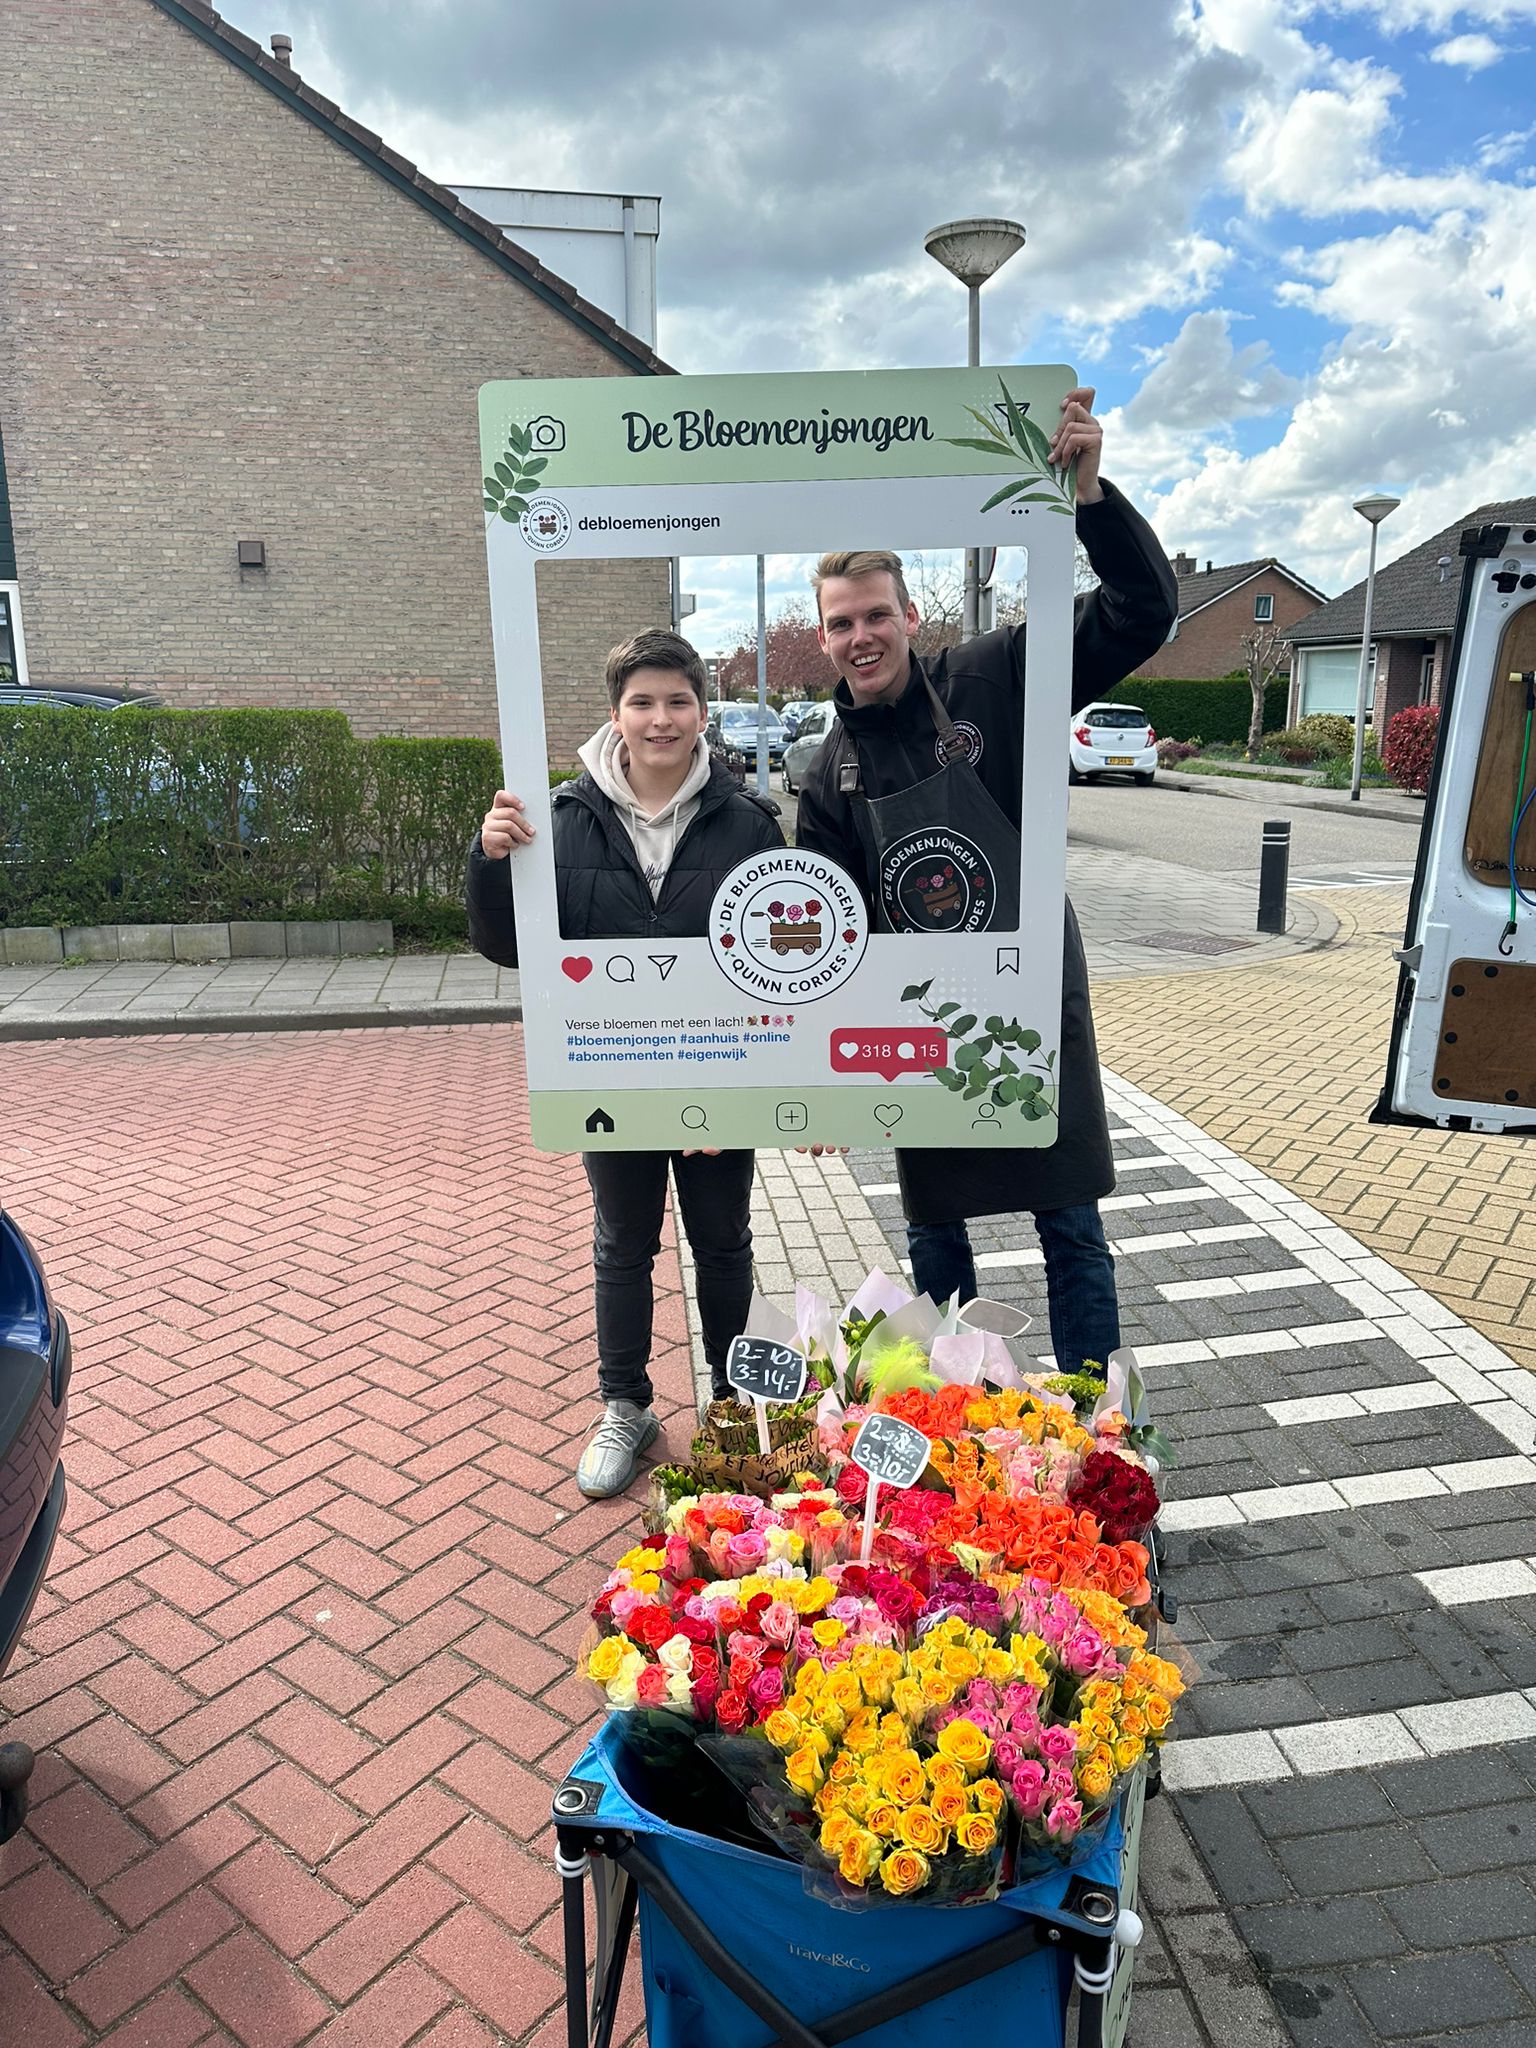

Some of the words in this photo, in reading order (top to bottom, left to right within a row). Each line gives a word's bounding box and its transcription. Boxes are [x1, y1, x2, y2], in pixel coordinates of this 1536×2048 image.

[621, 412, 673, 453] De
[673, 408, 934, 454] Bloemenjongen
[578, 514, 721, 532] debloemenjongen
[884, 836, 978, 882] BLOEMENJONGEN
[720, 899, 736, 921] DE
[730, 859, 857, 918] BLOEMENJONGEN
[884, 882, 893, 901] DE
[961, 899, 986, 934] RDES
[732, 958, 782, 993] QUINN
[788, 954, 847, 994] CORDES
[565, 1018, 600, 1030] Verse
[603, 1017, 657, 1029] bloemen
[661, 1017, 685, 1028] met
[688, 1018, 711, 1028] een
[714, 1016, 744, 1028] lach!
[567, 1033, 676, 1047] #bloemenjongen
[680, 1032, 739, 1044] #aanhuis
[743, 1031, 790, 1043] #online
[861, 1044, 891, 1058] 318
[920, 1044, 939, 1058] 15
[568, 1050, 674, 1062] #abonnementen
[677, 1048, 748, 1062] #eigenwijk
[788, 1942, 871, 1973] Travel&Co
